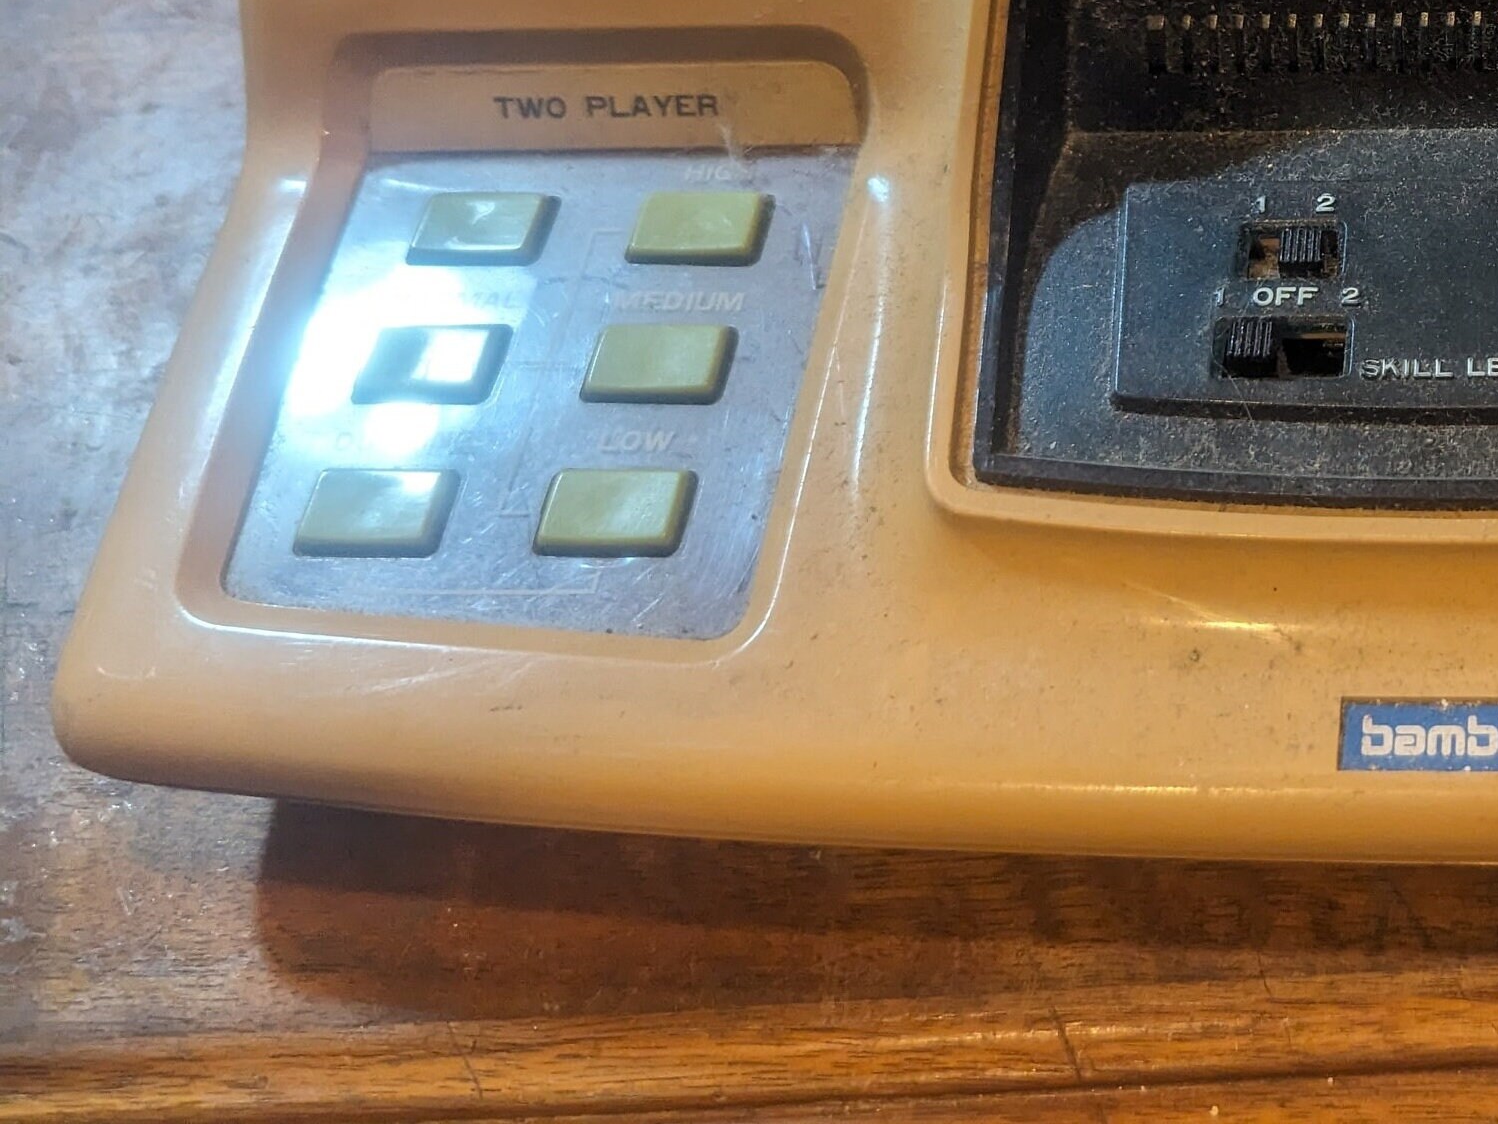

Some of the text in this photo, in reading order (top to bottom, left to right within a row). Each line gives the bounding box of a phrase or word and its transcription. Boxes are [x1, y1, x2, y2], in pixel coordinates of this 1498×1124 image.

[493, 93, 720, 119] TWO PLAYER
[1255, 196, 1266, 214] 1
[1315, 194, 1336, 214] 2
[613, 290, 745, 312] MEDIUM
[1252, 288, 1320, 306] OFF
[1341, 287, 1361, 305] 2
[1361, 358, 1453, 379] SKILL
[601, 429, 675, 453] LOW
